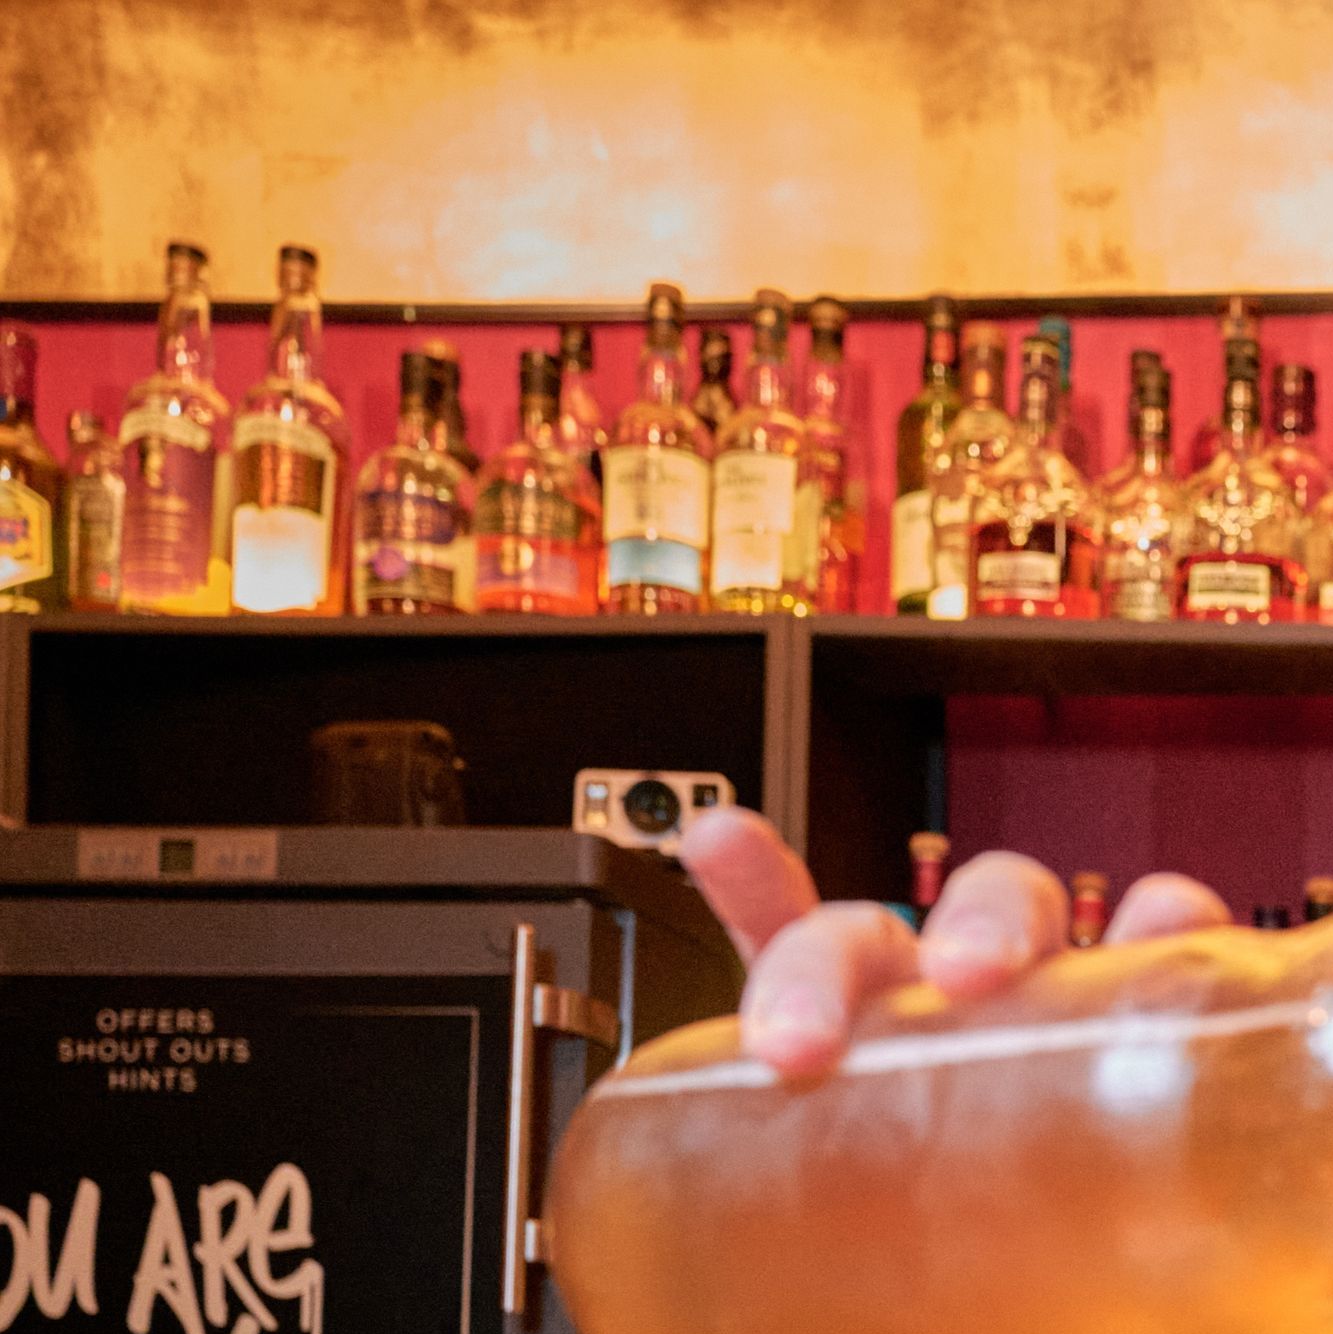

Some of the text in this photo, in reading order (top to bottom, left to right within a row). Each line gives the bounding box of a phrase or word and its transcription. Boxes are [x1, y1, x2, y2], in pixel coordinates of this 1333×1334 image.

[95, 1008, 215, 1034] OFFERS
[57, 1037, 250, 1063] SHOUT OUTS
[108, 1067, 198, 1092] HINTS
